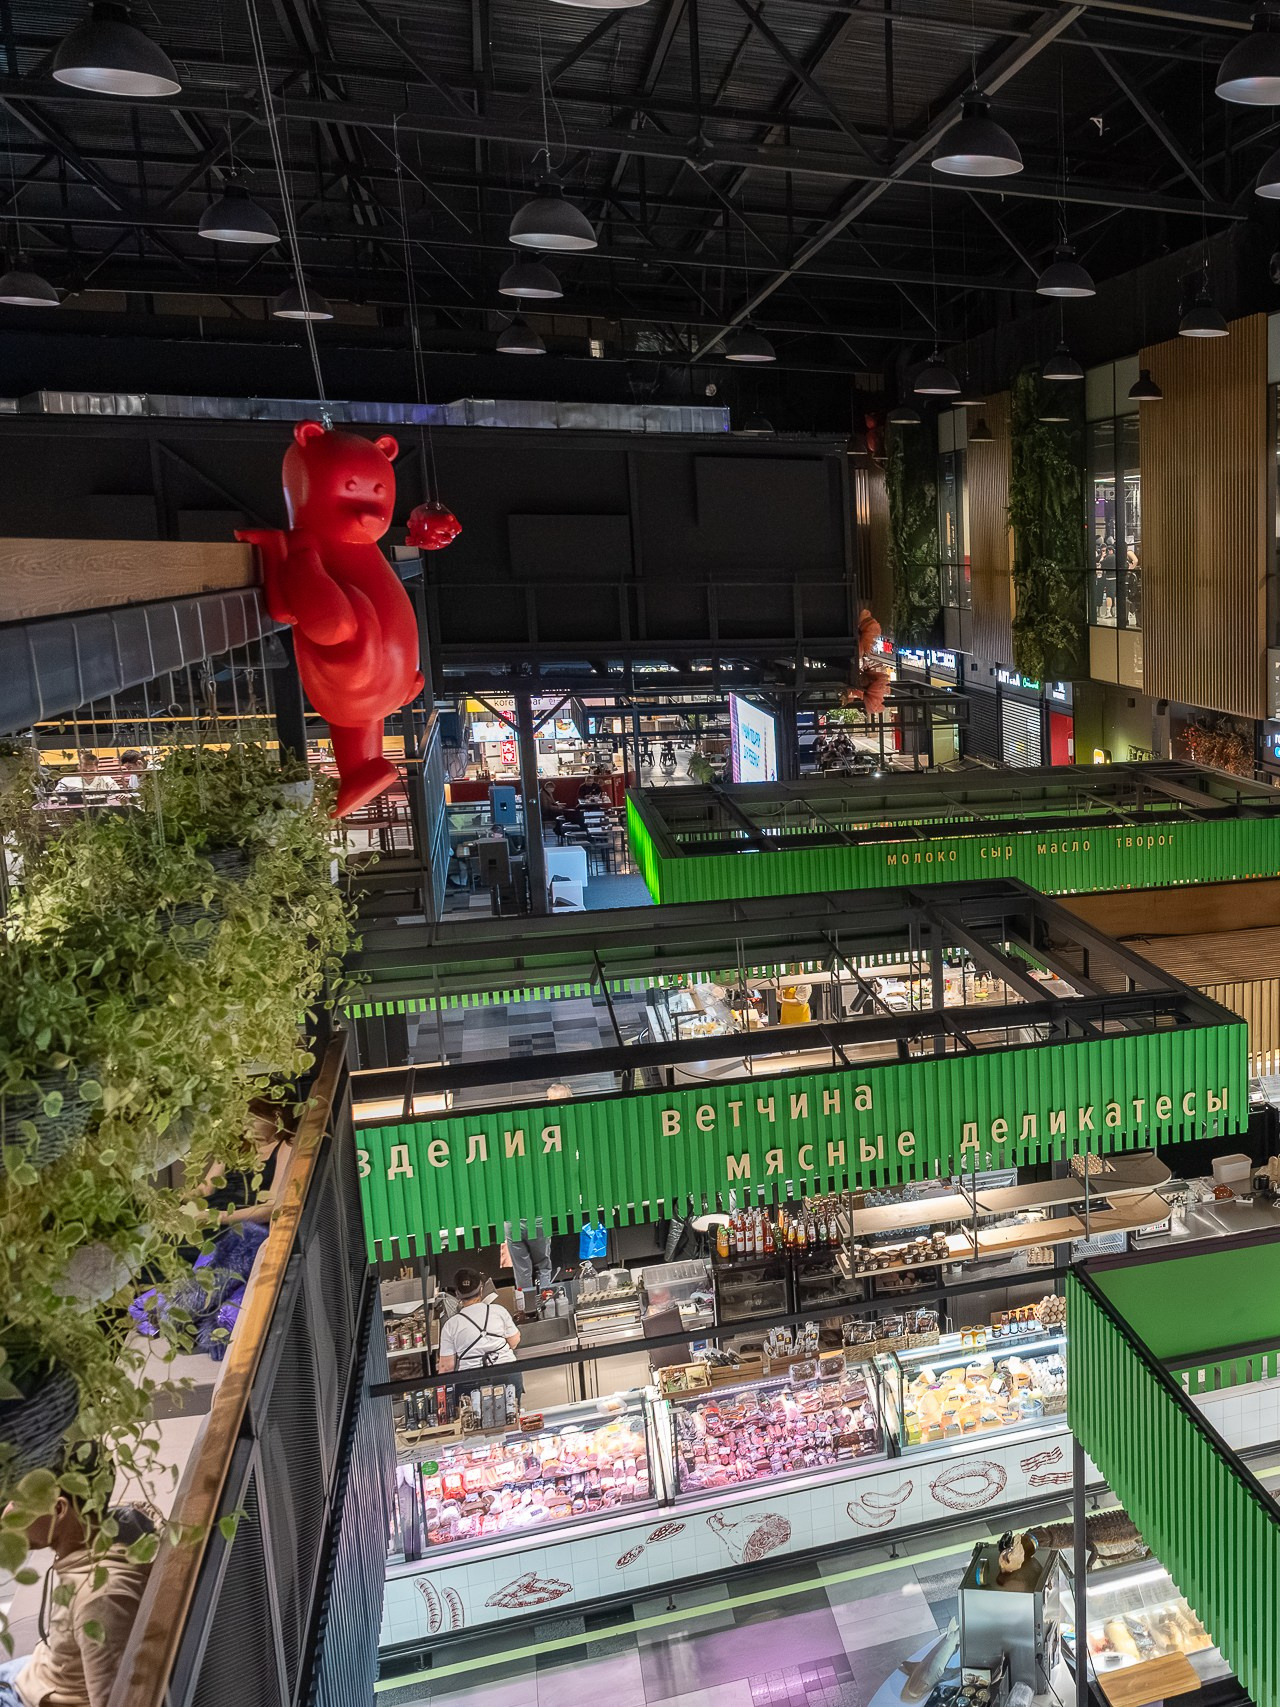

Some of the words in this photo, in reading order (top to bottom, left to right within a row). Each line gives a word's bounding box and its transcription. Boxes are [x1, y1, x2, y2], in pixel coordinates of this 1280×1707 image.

[887, 850, 957, 865] молоко
[980, 845, 1013, 860] сыр
[1037, 840, 1090, 854] масло
[1116, 834, 1174, 849] творог
[661, 1084, 873, 1137] ветчина
[726, 1130, 916, 1181] мясные
[959, 1087, 1229, 1154] деликатесы
